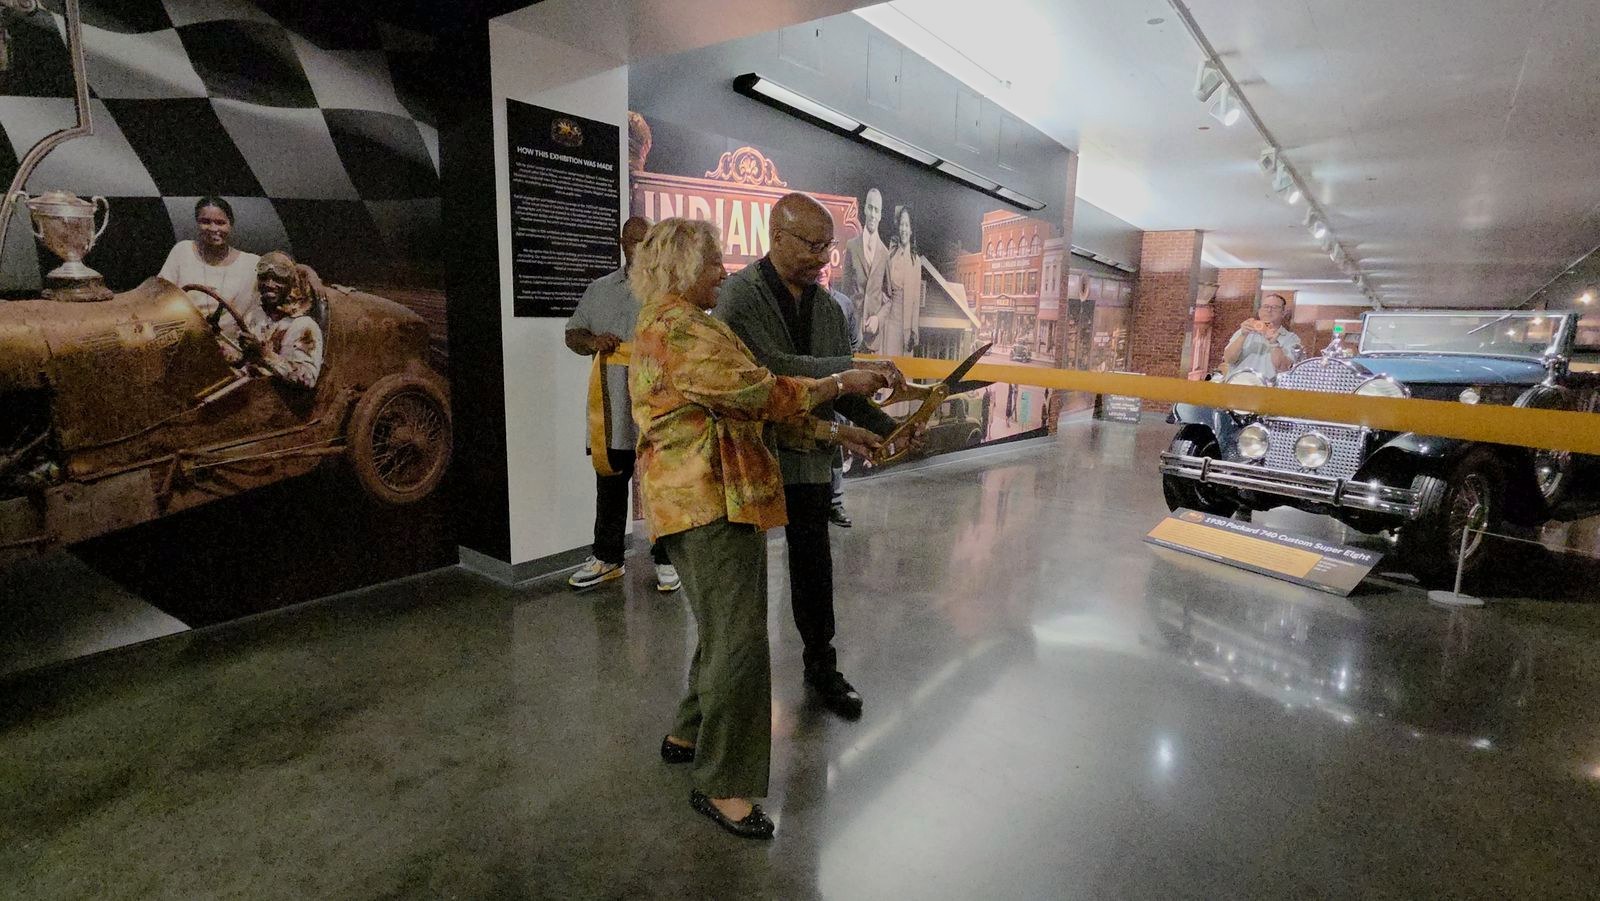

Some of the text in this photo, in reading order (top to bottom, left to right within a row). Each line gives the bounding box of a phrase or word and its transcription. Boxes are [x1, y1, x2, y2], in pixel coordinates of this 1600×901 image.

[517, 146, 613, 171] HOW THIS EXHIBITION WAS MADE
[1204, 517, 1372, 562] 1930 Packard 740 Custom Super Eight
